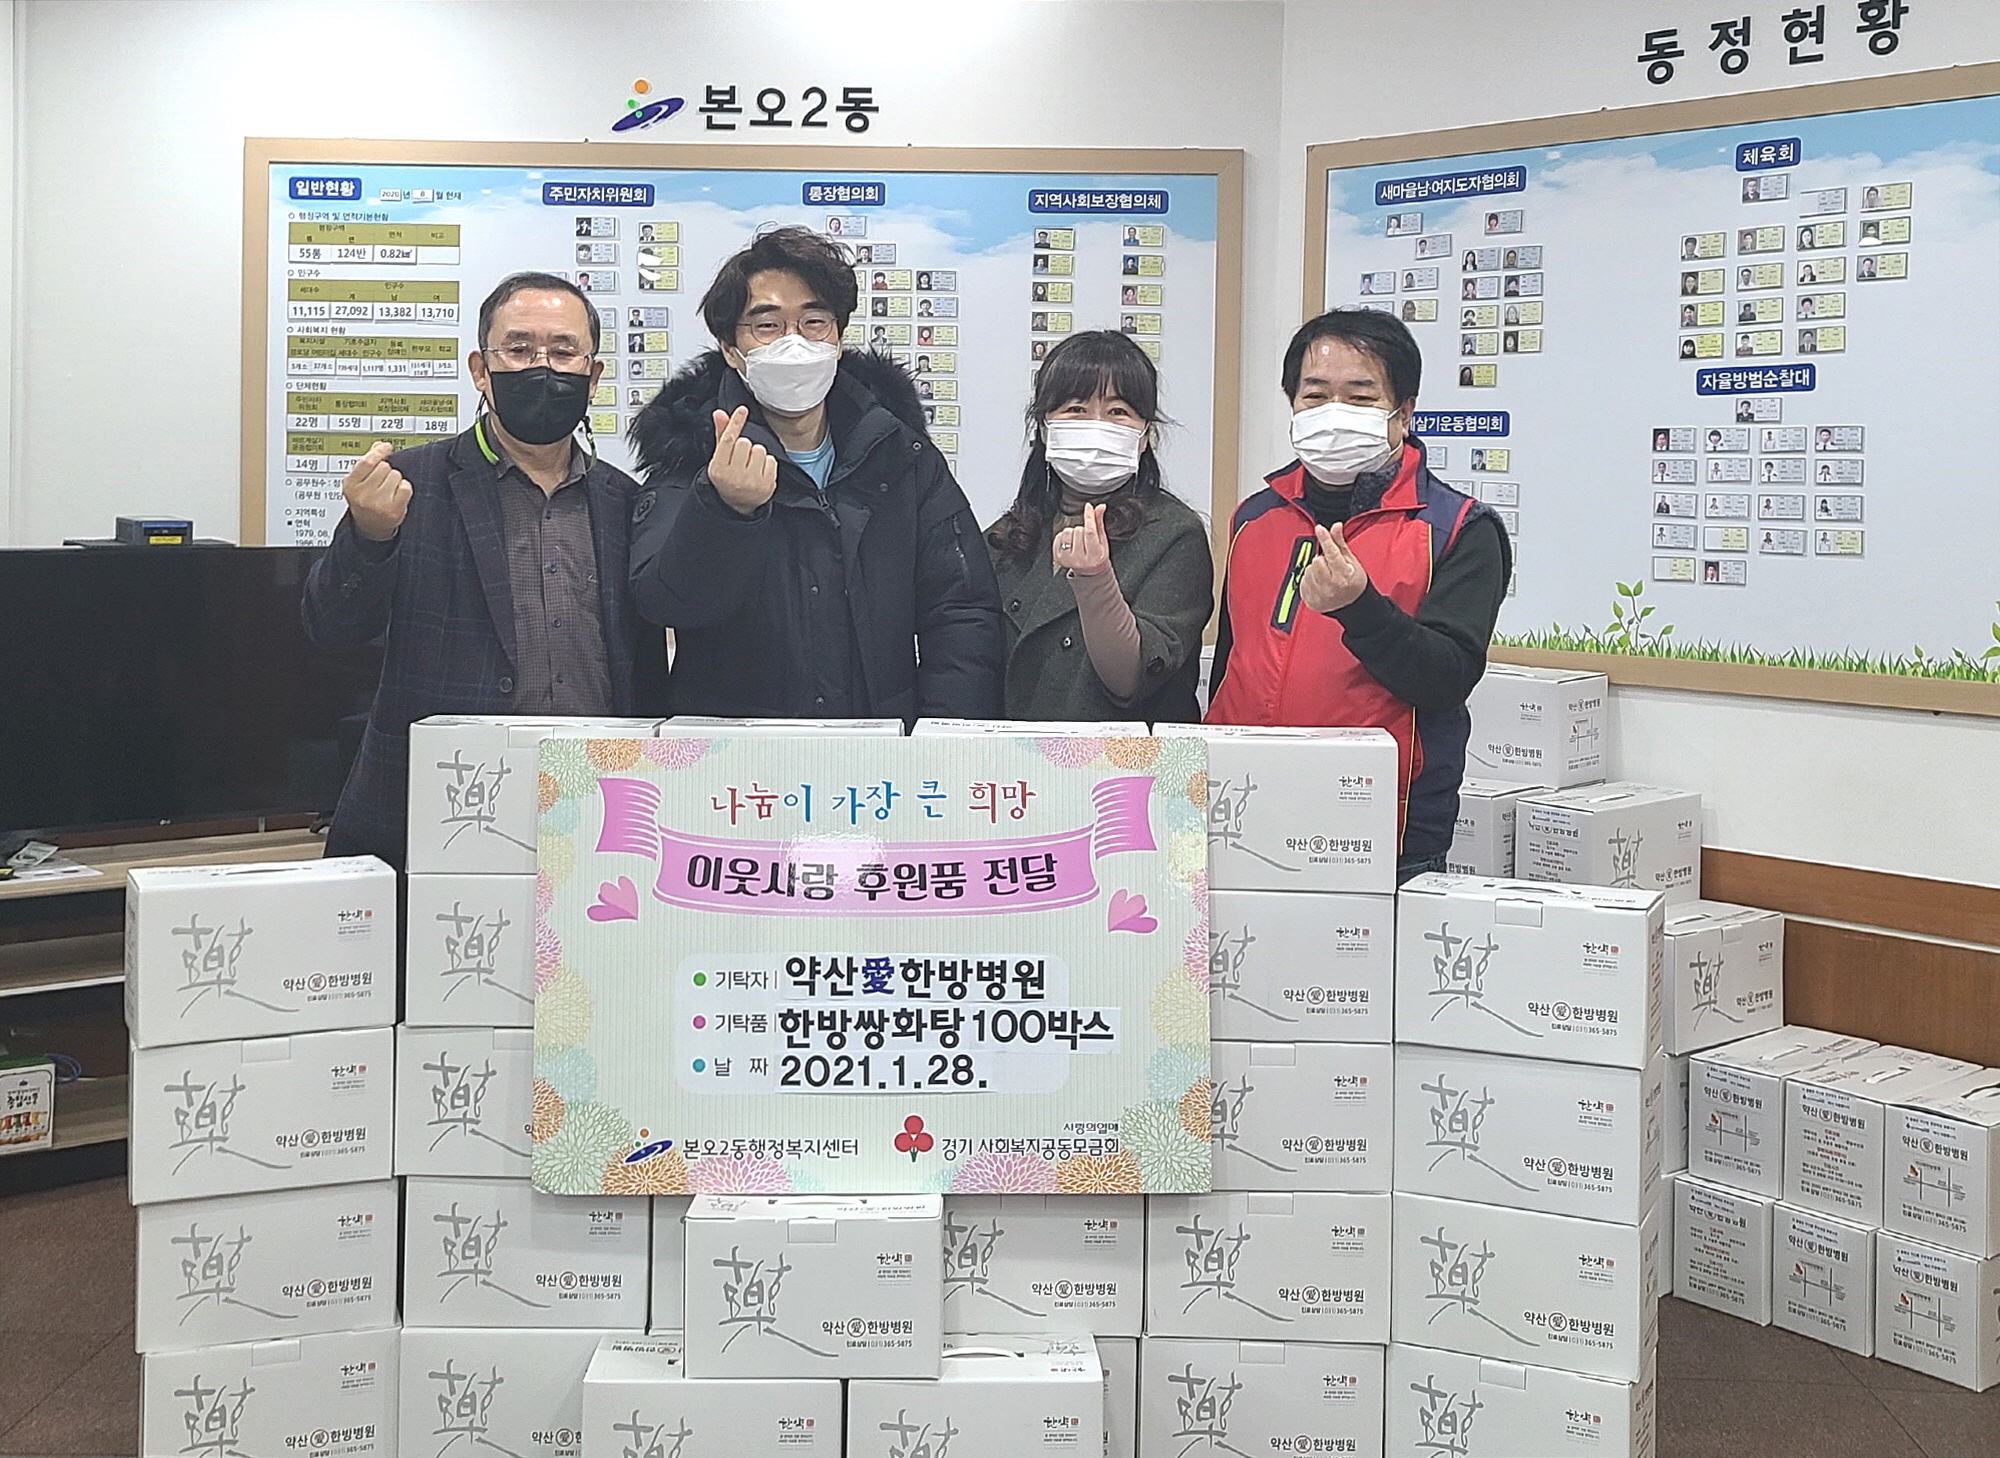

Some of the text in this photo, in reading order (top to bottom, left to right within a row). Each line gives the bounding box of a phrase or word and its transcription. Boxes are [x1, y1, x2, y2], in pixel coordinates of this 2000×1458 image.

[698, 84, 880, 133] 본오2동
[1742, 148, 1794, 165] 체육회
[296, 179, 355, 197] 일반현황
[549, 185, 647, 203] 주민자치위원회
[808, 185, 879, 202] 통장협의회
[1034, 193, 1161, 209] 지역사회보장협의체
[299, 248, 321, 259] 55통
[338, 248, 366, 259] 124반
[293, 306, 454, 318] 11,115 27,092 13,382 13,710
[1702, 370, 1809, 390] 자율방범순찰대
[296, 417, 447, 432] 22명 55명 22명 18명
[296, 459, 318, 470] 14명
[711, 780, 1036, 824] 나눔이 가장 큰 희망
[687, 853, 1057, 900] 이웃사랑 후원품 전달
[715, 970, 769, 990] 기탁자
[715, 1010, 1113, 1049] 기탁품 한방쌍화탕 100박스
[780, 1056, 989, 1088] 2021.1.28.
[1064, 1122, 1119, 1133] 사랑의열매
[683, 1138, 858, 1159] 본오2동행정복지센터
[942, 1137, 1119, 1158] 경기 사회복지공동모금회
